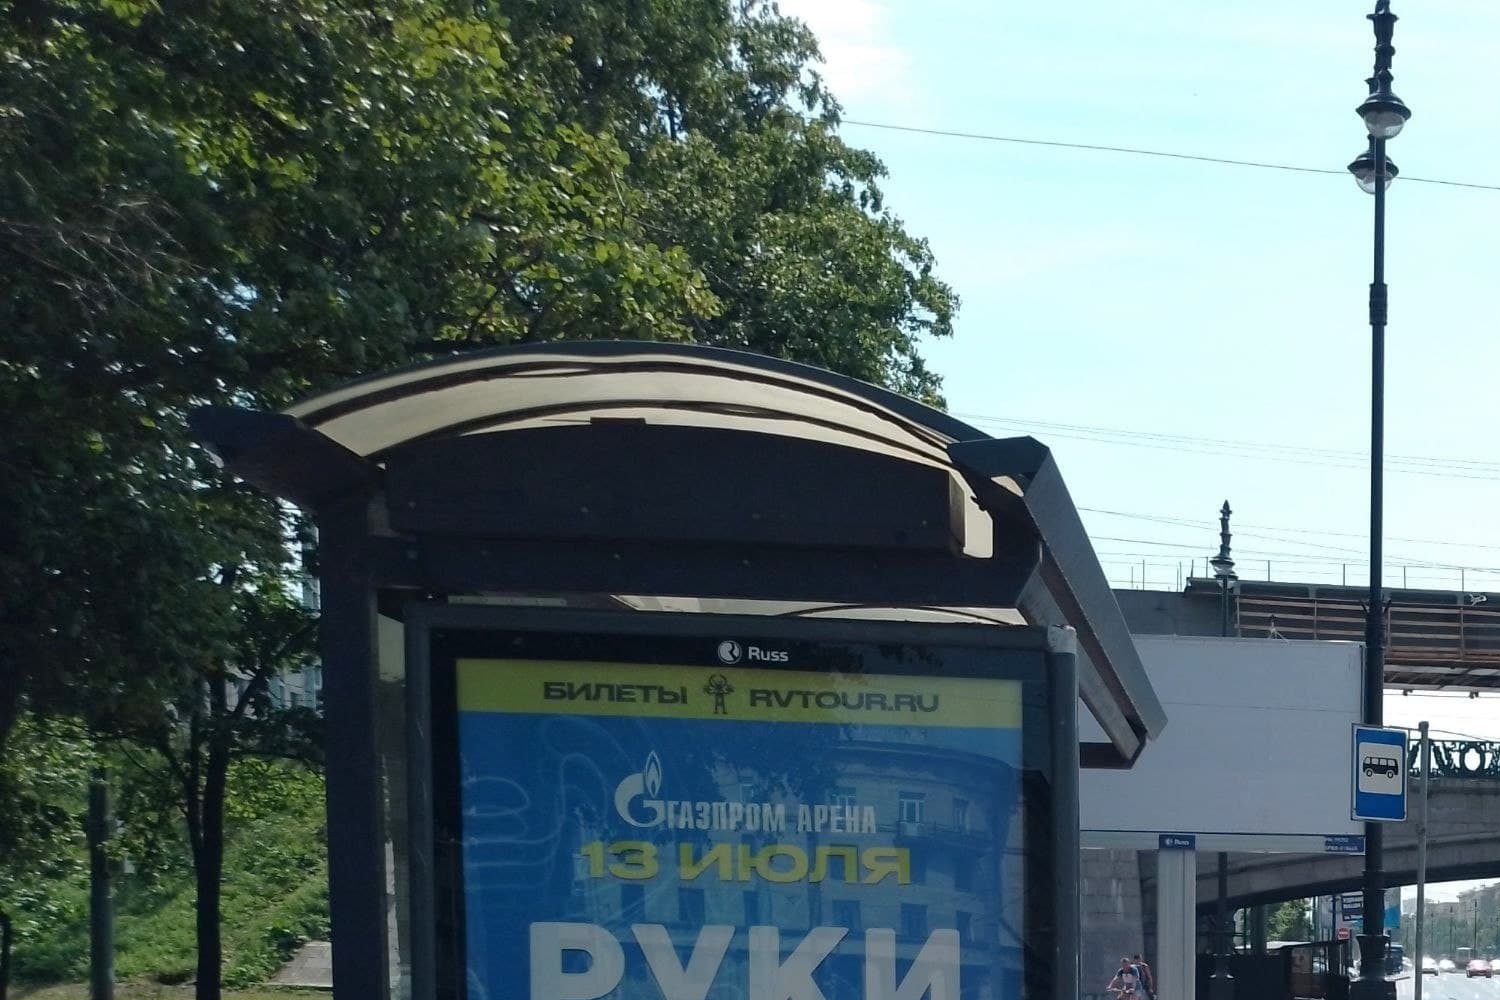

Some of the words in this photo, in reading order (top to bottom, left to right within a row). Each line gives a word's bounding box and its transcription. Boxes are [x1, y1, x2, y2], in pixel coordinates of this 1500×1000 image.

[748, 644, 789, 663] Russ
[543, 681, 688, 705] БИЛЕТЫ
[749, 688, 940, 714] RVTOUR.RU
[667, 799, 786, 833] ГАЗПРОМ
[797, 803, 876, 834] АРЕНА
[580, 840, 660, 880] 13
[678, 842, 911, 885] ИЮЛЯ
